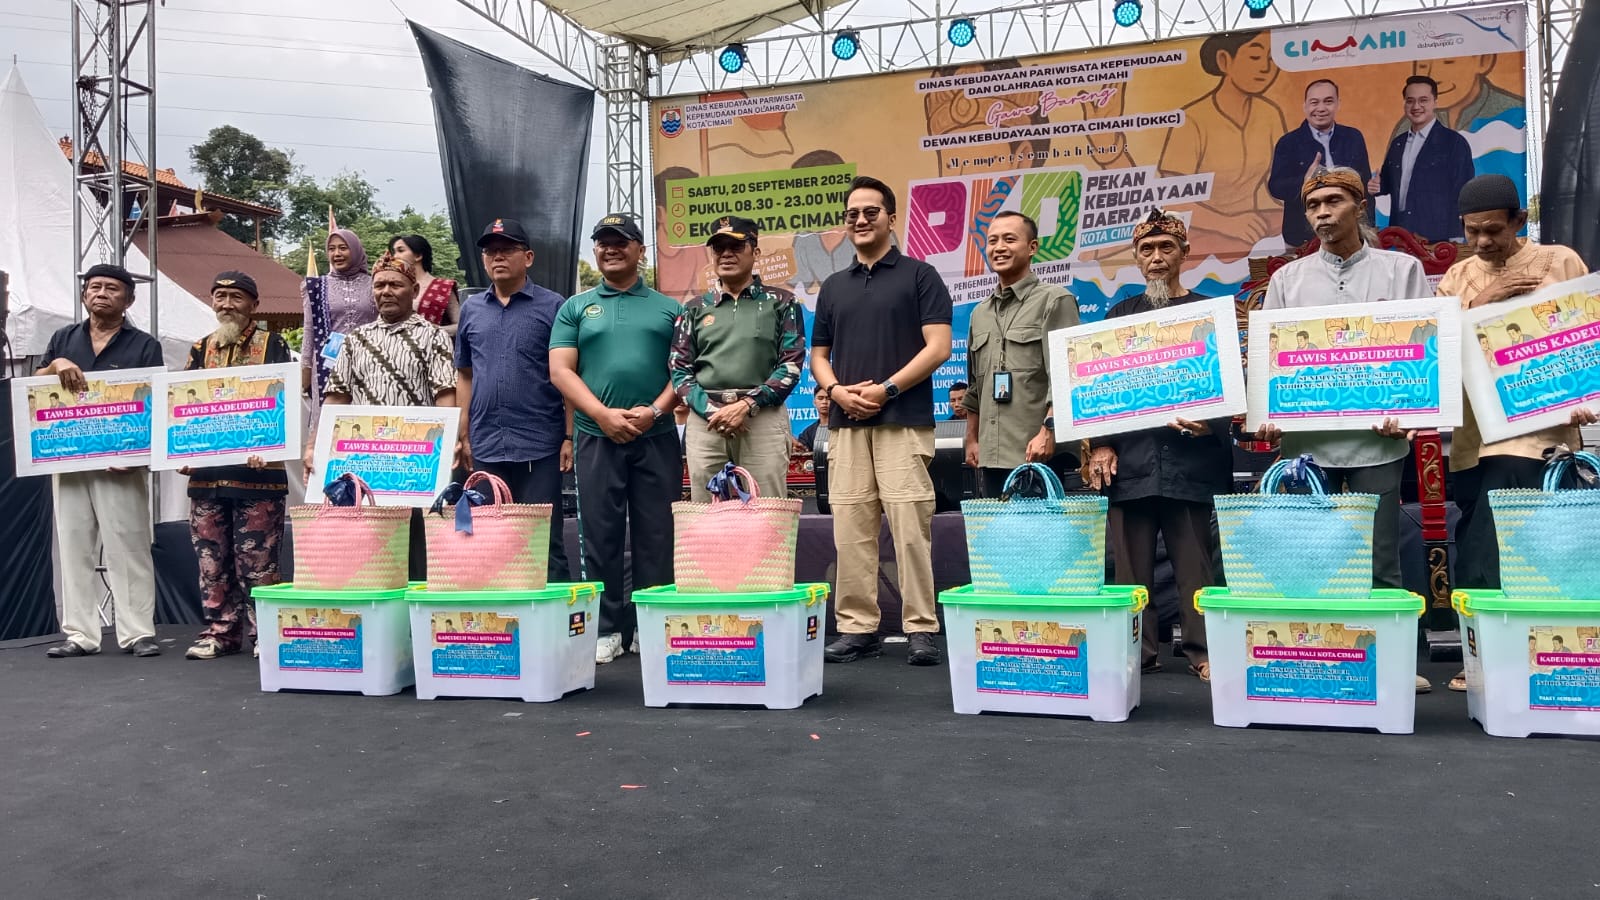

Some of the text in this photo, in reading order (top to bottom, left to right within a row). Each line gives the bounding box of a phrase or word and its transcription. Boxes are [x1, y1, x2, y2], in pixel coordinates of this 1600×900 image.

[1284, 30, 1406, 58] CIMAHI
[919, 53, 1182, 90] DINAS KEBUDAYAAN PARIWISATA KEPEMUDAAN
[968, 70, 1128, 95] DAN OLAHRAGA KOTA CIMAHI
[686, 93, 804, 113] DINAS KEBUDAYAAN PARIWISATA
[686, 109, 736, 121] KEPEMUDAAN
[755, 103, 796, 114] OLAHRAGA
[987, 88, 1115, 127] Gawe Bareng
[687, 118, 733, 129] KOTA CIMAHI
[923, 113, 1181, 148] DEWAN KEBUDAYAAN KOTA CIMAHI (DKKC)
[688, 173, 852, 198] SABTU, 20 SEPTEMBER 2025
[1086, 171, 1146, 192] PEKAN
[689, 201, 732, 216] PUKUL
[735, 197, 773, 212] 08.30
[784, 193, 824, 208] 23.00
[826, 190, 848, 203] WI
[1084, 181, 1208, 211] KEBUDAYAAN
[790, 211, 847, 229] CIMAH
[1081, 231, 1107, 245] KOTA
[1085, 346, 1197, 374] TAWIS KADEUDEUH
[1288, 348, 1414, 364] TAWIS KADEUDEUH
[1505, 340, 1548, 361] TAWIS
[43, 404, 137, 420] TAWIS KADEUDEUH
[180, 400, 269, 416] TAWIS KADEUDEUH
[343, 442, 370, 451] TAWIS
